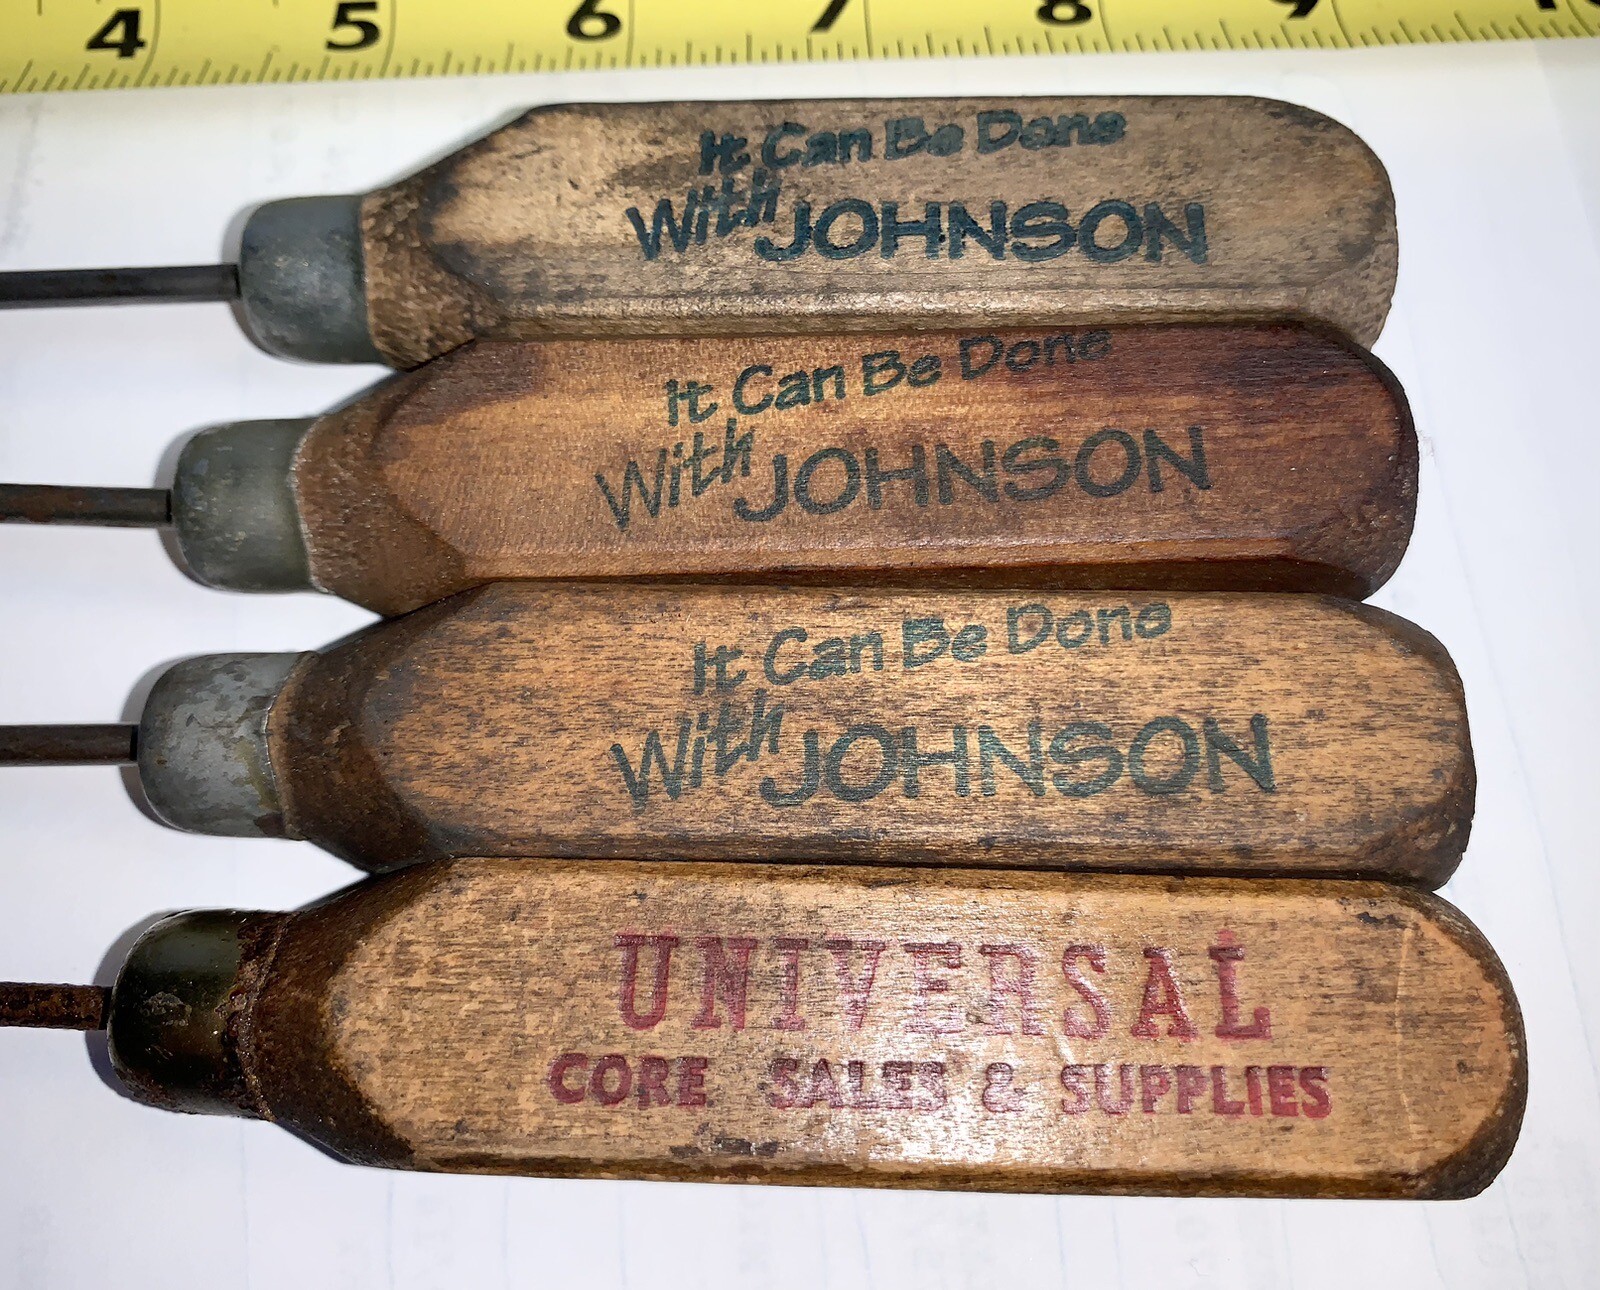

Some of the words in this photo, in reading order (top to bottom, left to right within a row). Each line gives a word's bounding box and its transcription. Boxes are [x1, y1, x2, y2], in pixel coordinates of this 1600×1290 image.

[86, 9, 147, 58] 4
[325, 0, 382, 52] 5
[565, 0, 622, 42] 6
[761, 121, 872, 170] Can
[884, 115, 964, 160] Be
[624, 167, 781, 262] With
[754, 197, 1209, 263] JOHNSON
[666, 379, 718, 426] It
[732, 364, 846, 416] Can
[862, 350, 942, 396] Be
[958, 329, 1112, 381] Done
[595, 418, 754, 532] With
[733, 425, 1212, 522] JOHNSON
[692, 640, 747, 696] It
[762, 627, 884, 686] Can
[902, 617, 989, 669] Be
[1006, 601, 1172, 655] Done
[609, 689, 789, 814] With
[758, 712, 1279, 808] JOHNSON
[614, 929, 1271, 1042] UNIVERSAL
[547, 1053, 709, 1107] CORE
[766, 1058, 949, 1112] SALES
[981, 1062, 1023, 1114] &
[1060, 1063, 1333, 1119] SUPPLIES
